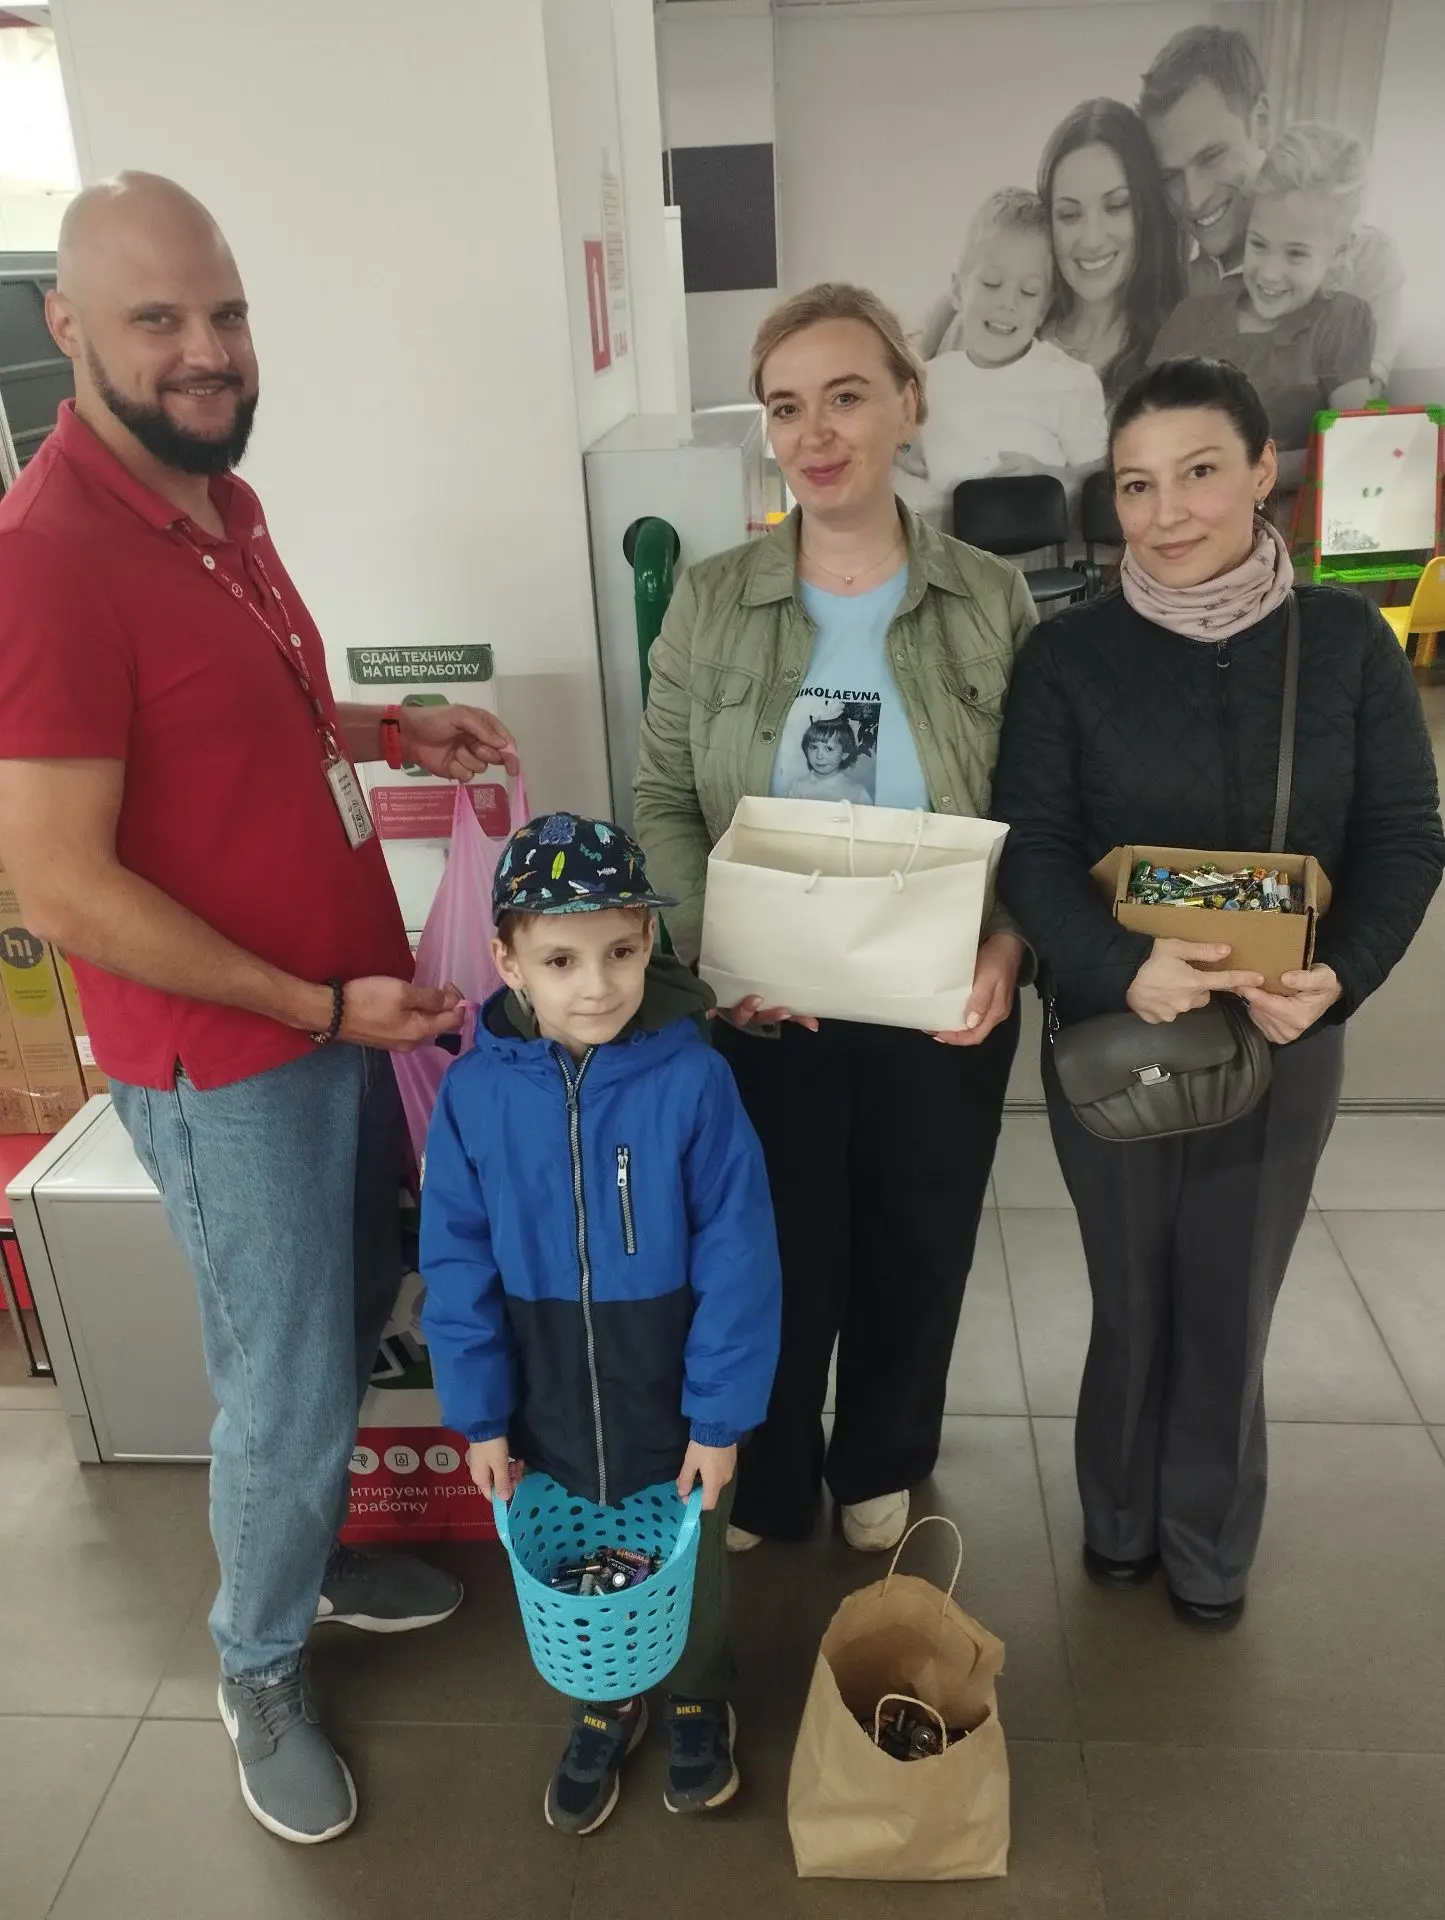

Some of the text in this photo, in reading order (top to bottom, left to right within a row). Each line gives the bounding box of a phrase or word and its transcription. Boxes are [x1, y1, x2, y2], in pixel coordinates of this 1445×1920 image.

[360, 649, 464, 665] СДАЙ ТЕХНИКУ
[362, 663, 480, 678] НА ПЕРЕРАБОТКУ
[676, 1704, 702, 1716] BIKER
[583, 1715, 608, 1731] BIKER
